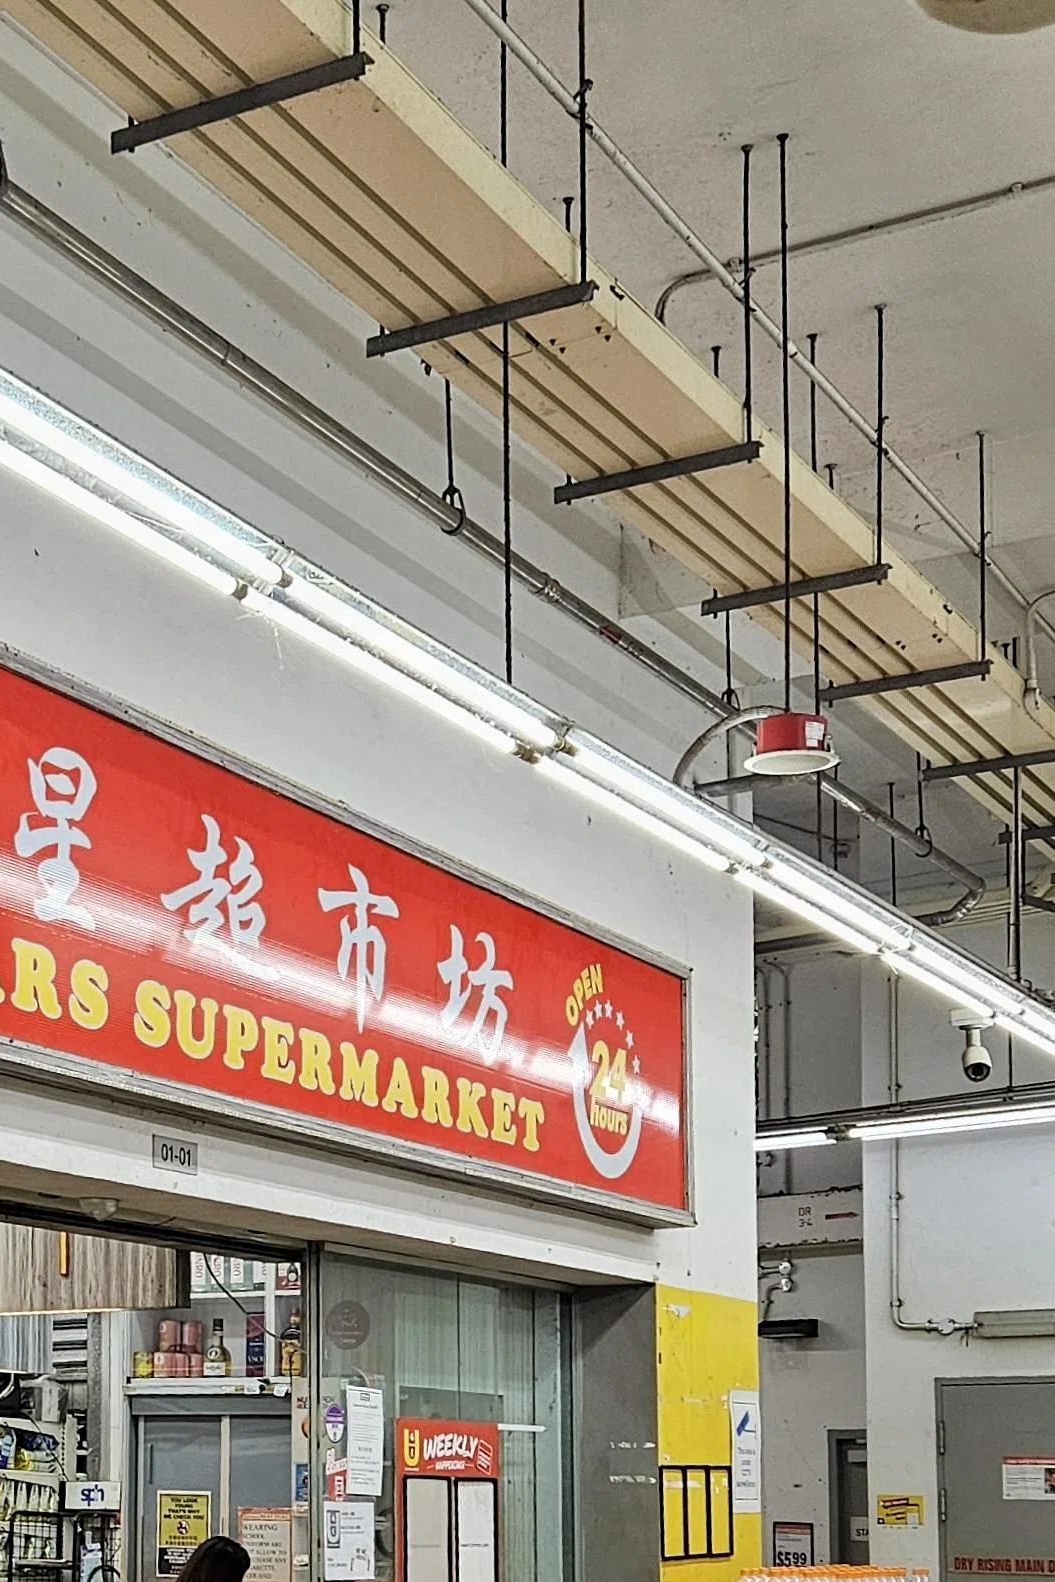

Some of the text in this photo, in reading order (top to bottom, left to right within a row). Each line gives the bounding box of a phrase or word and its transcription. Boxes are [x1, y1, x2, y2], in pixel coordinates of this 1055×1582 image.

[565, 963, 604, 1027] OPEN
[133, 980, 546, 1153] SUPERMARKET
[589, 1040, 628, 1103] 24
[590, 1096, 628, 1136] hours
[160, 1143, 193, 1167] 01-01
[423, 1432, 479, 1460] WEEKLY
[954, 1557, 974, 1570] DRY
[977, 1558, 1012, 1572] RISING
[1015, 1559, 1044, 1573] MAIN
